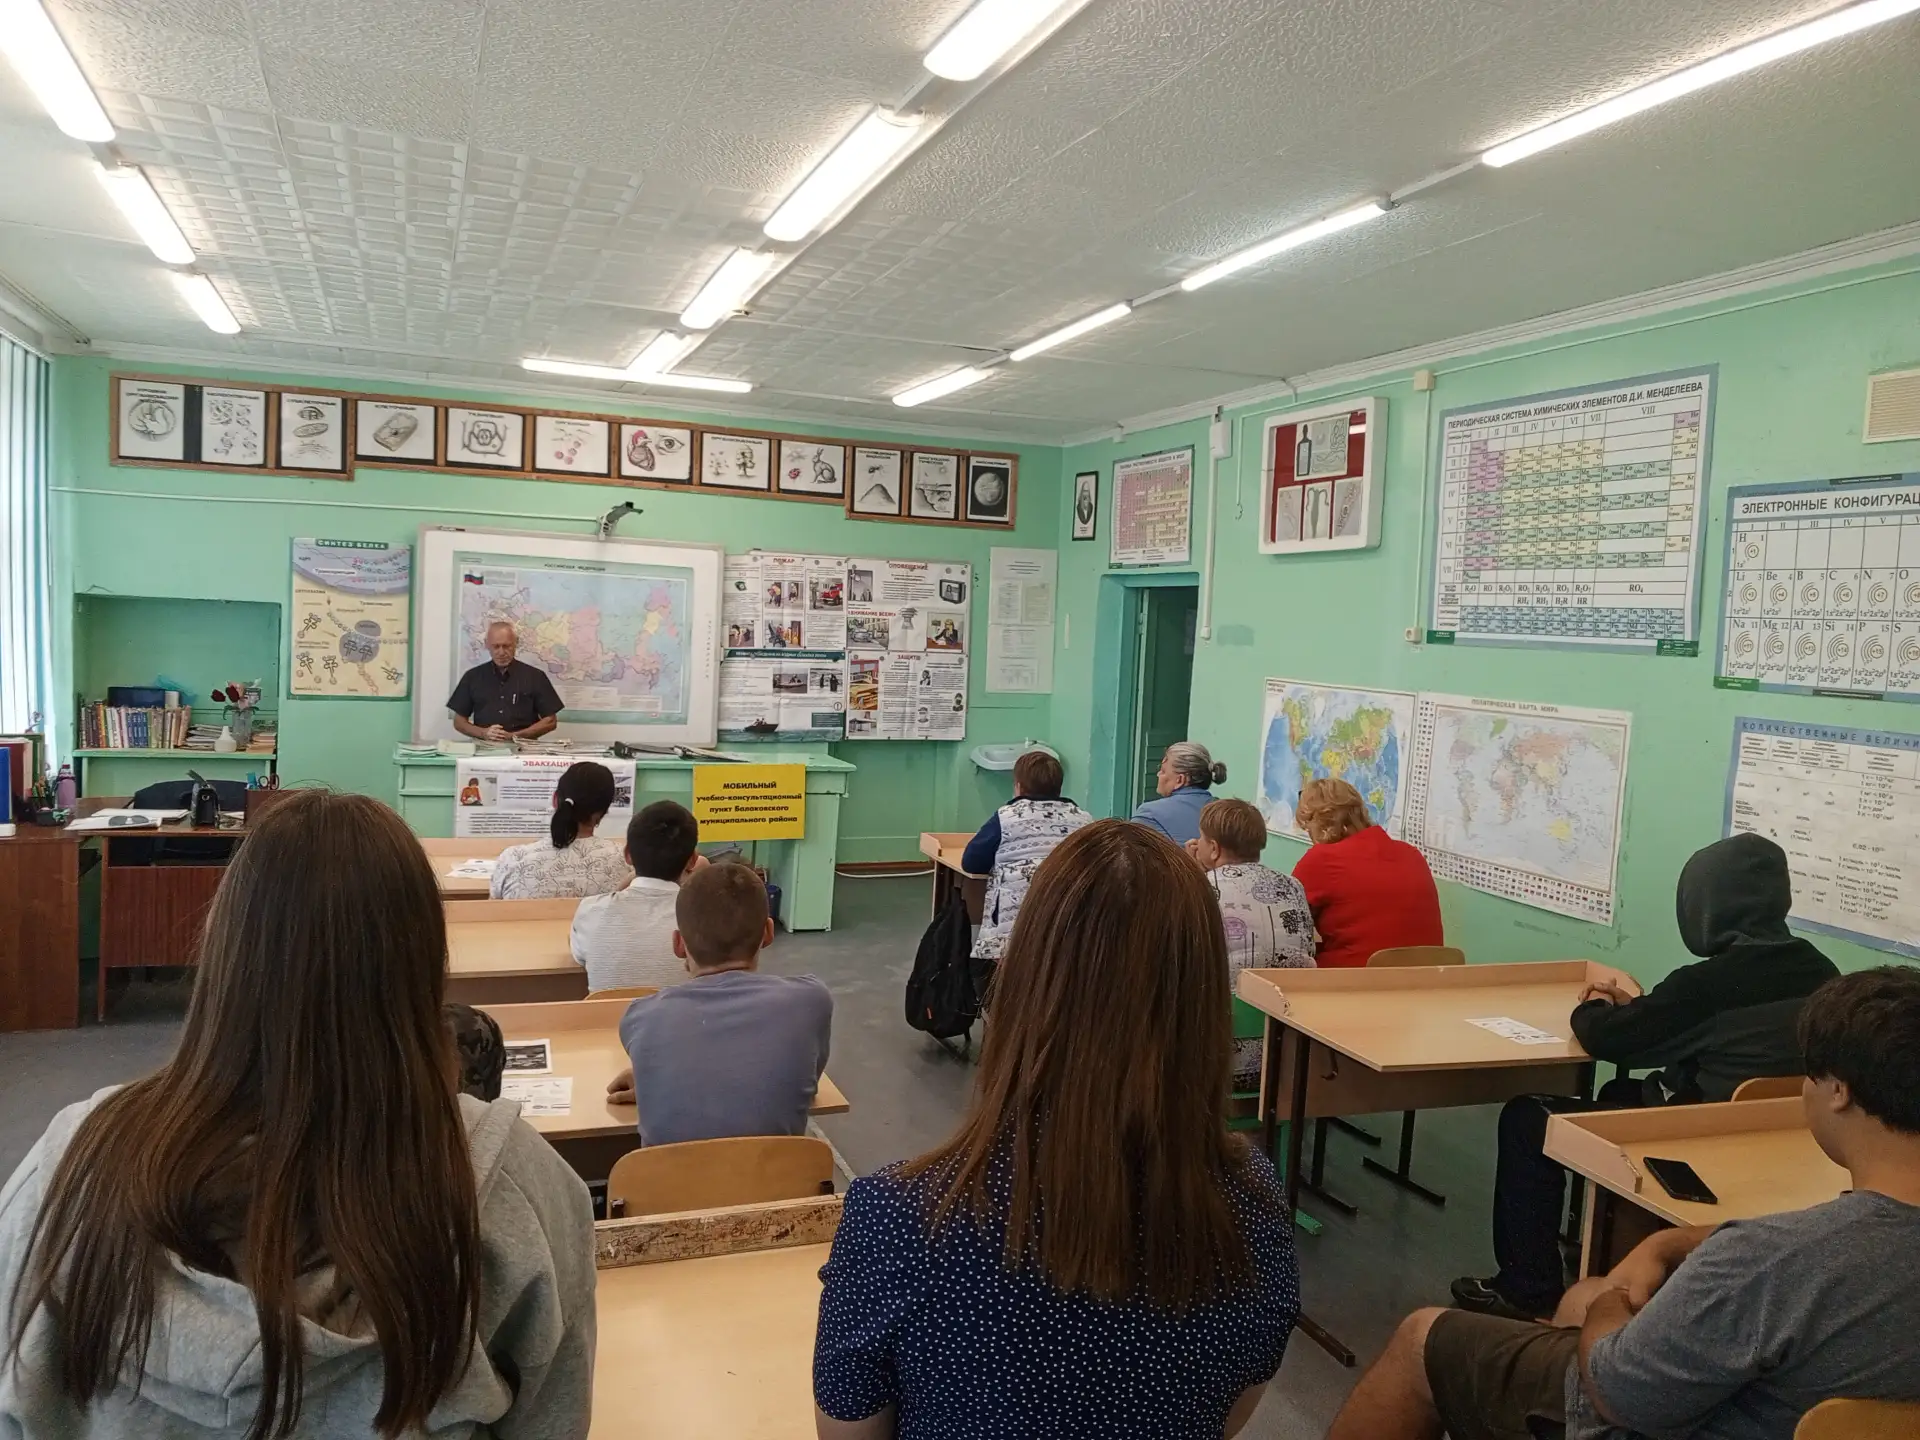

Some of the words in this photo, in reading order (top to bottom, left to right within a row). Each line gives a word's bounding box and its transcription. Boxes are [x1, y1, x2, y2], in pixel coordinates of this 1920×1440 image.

[1448, 413, 1500, 429] ПЕРИОДИЧЕСКАЯ
[1501, 409, 1532, 421] СИСТЕМА
[1533, 400, 1580, 417] ХИМИЧЕСКИХ
[1582, 394, 1628, 409] ЭЛЕМЕНТОВ
[1629, 391, 1645, 403] Д.И.
[1646, 382, 1703, 399] МЕНДЕЛЕЕВА
[1641, 406, 1655, 415] VIII
[1742, 498, 1828, 514] ЭЛЕКТРОННЫЕ
[1739, 533, 1747, 542] H
[1736, 572, 1745, 581] Li
[1766, 572, 1777, 581] Be
[1797, 571, 1804, 580] B
[1829, 570, 1838, 580] C
[1863, 570, 1873, 580] N
[1899, 569, 1909, 580] O
[1577, 597, 1588, 605] HR
[1733, 619, 1745, 628] Na
[1762, 620, 1777, 632] Mg
[1793, 621, 1804, 630] Al
[1825, 621, 1835, 631] Si
[1859, 622, 1866, 632] P
[1881, 624, 1889, 632] 15
[1894, 623, 1901, 632] S
[1471, 698, 1516, 709] ПОЛИТИЧЕСКАЯ
[1518, 703, 1537, 711] КАРТА
[1742, 721, 1857, 741] КОЛИЧЕСТВЕННЫЕ
[1865, 734, 1920, 748] ВЕЛИЧИ
[723, 781, 777, 790] МОБИЛЬНЫЙ
[696, 794, 802, 803] учебно-консультационный
[709, 806, 732, 814] пункт
[734, 805, 789, 813] Балаковского
[700, 817, 766, 825] муниципального
[768, 816, 798, 824] района
